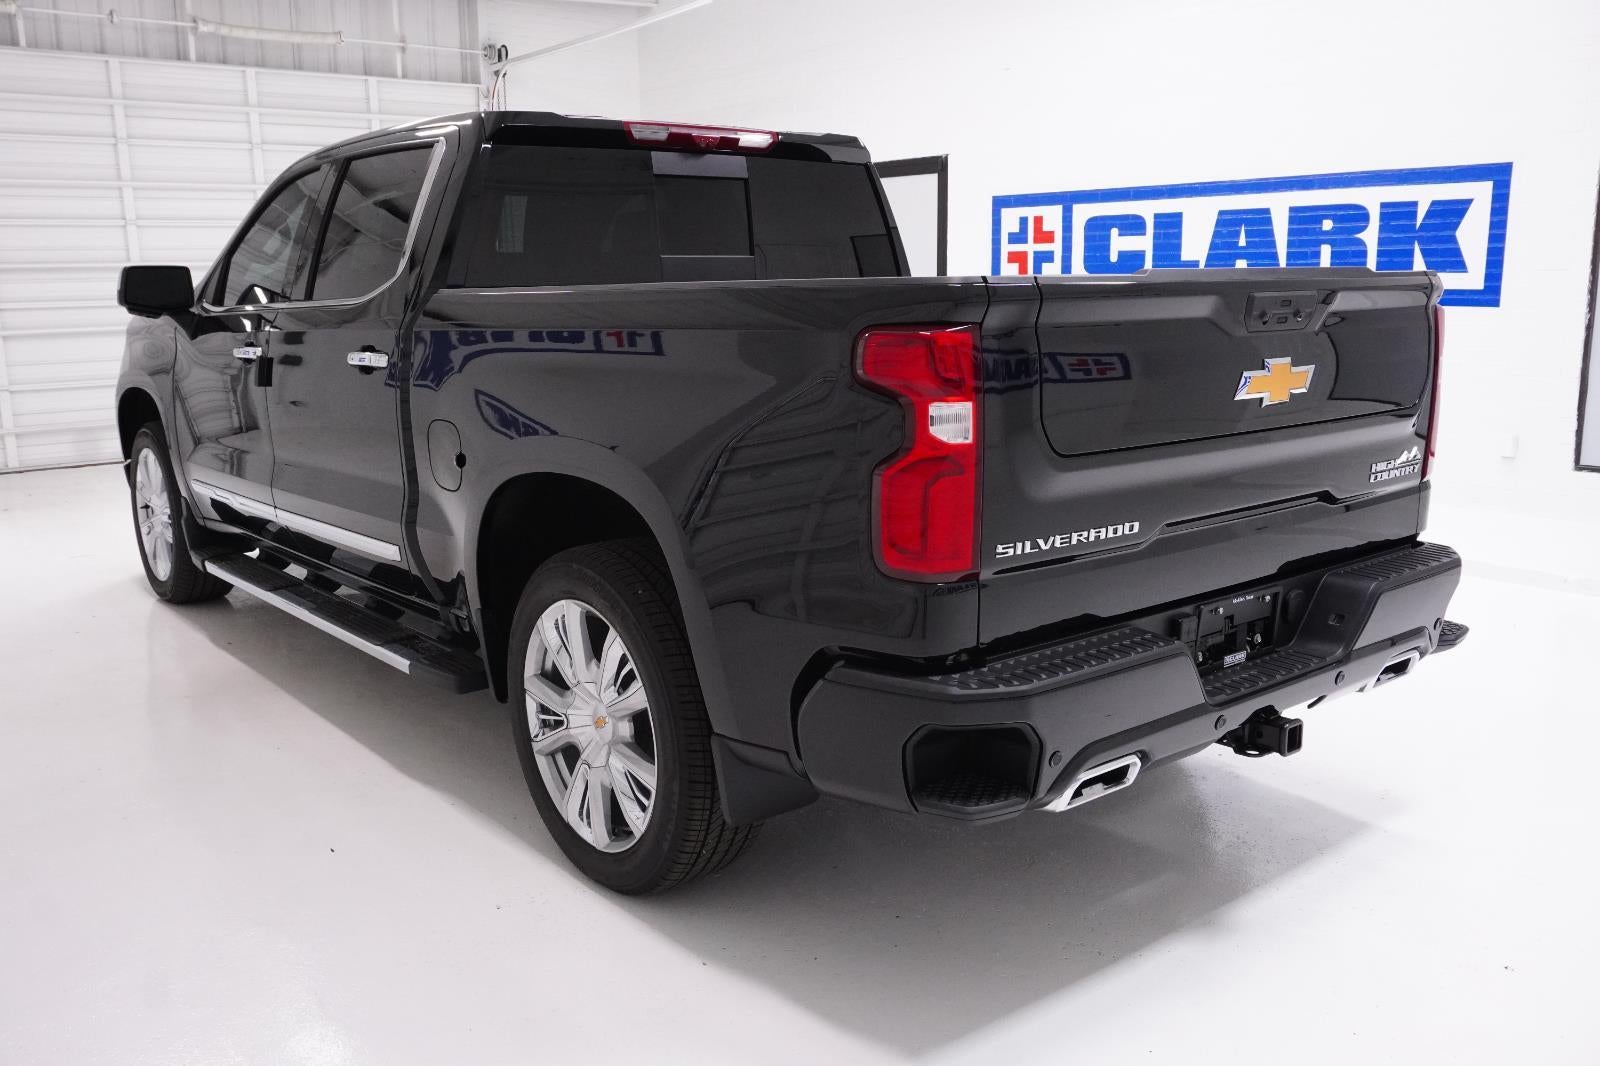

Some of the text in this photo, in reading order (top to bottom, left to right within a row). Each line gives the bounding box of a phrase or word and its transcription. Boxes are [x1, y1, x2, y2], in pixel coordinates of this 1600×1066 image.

[1083, 199, 1474, 275] CLARK
[1370, 463, 1420, 482] COUNTRY
[1371, 459, 1402, 473] HIGH
[996, 521, 1140, 559] SILVERADO
